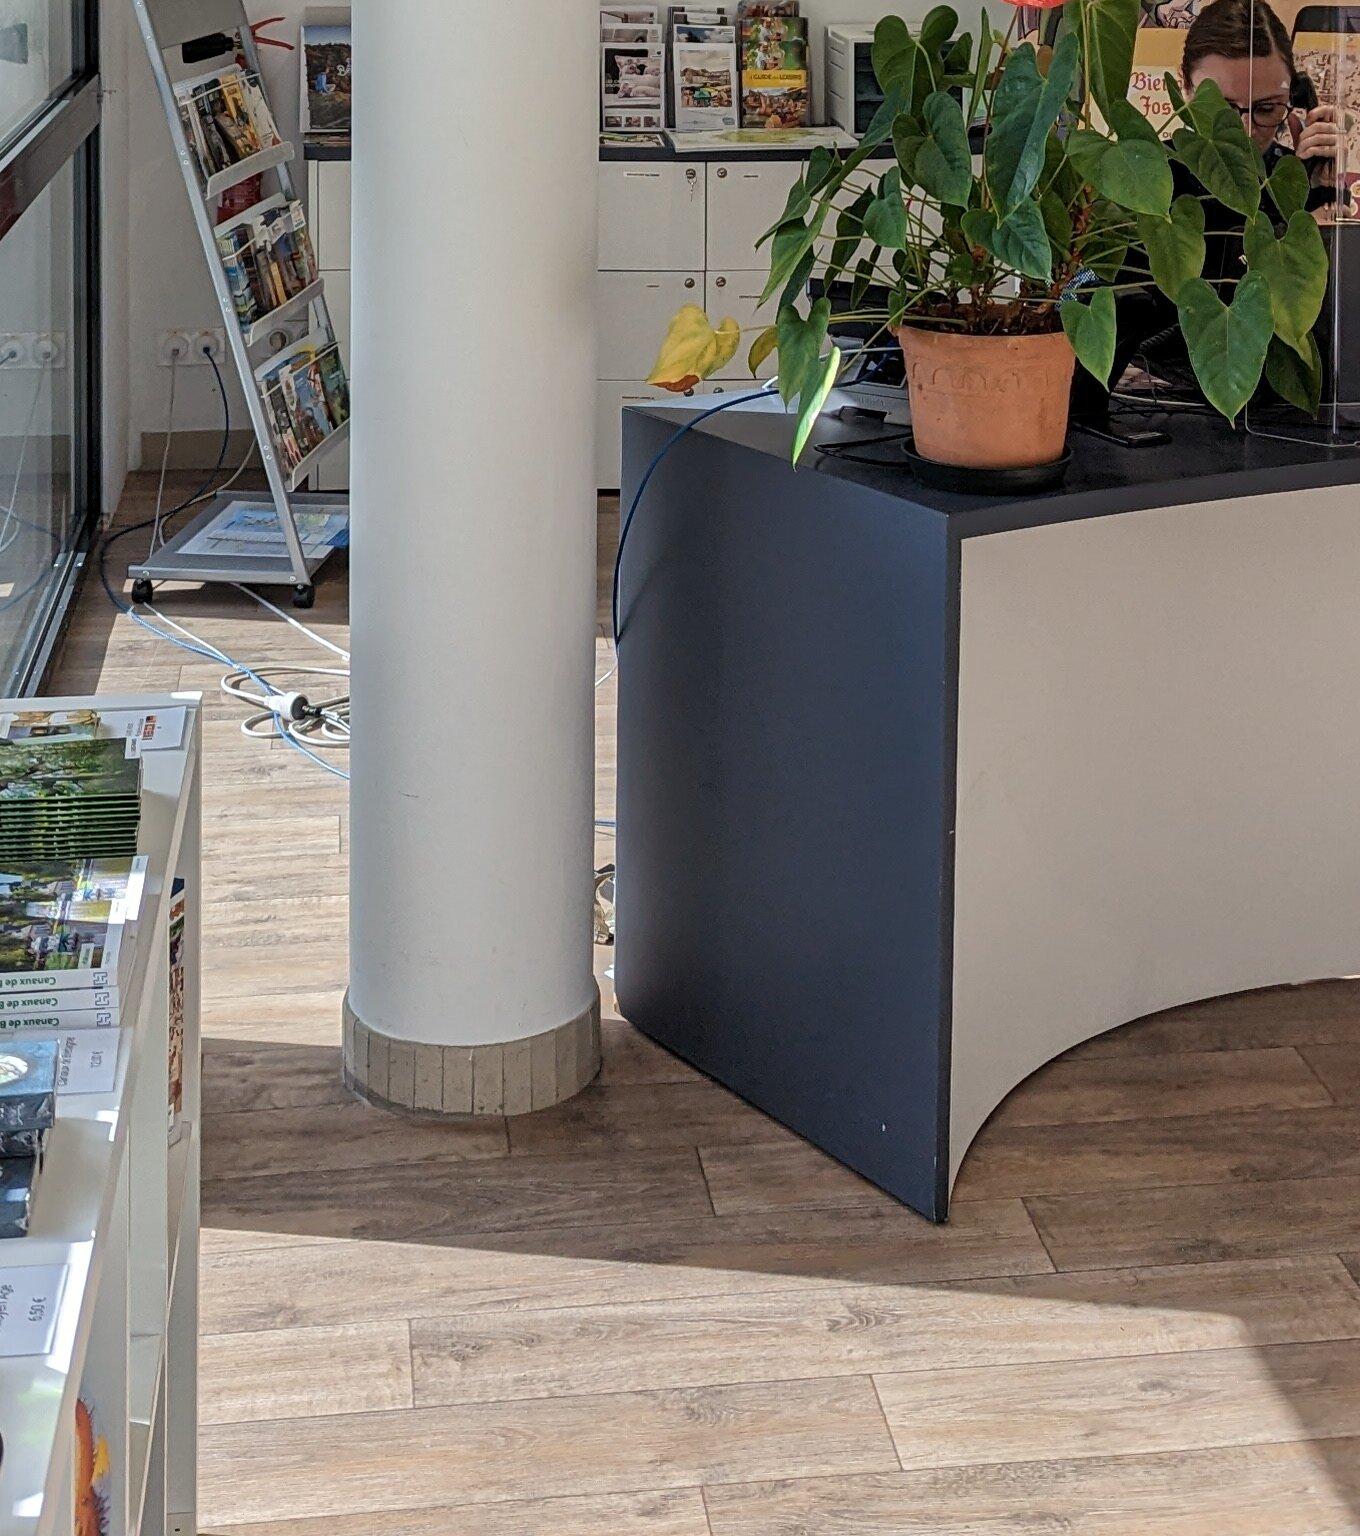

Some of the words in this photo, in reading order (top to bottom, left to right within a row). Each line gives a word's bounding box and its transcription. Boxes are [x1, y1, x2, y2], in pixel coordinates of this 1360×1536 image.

[5, 978, 17, 987] de
[19, 976, 57, 986] Canaux
[7, 999, 19, 1008] de
[21, 997, 58, 1007] Canaux
[8, 1019, 21, 1029] de
[23, 1017, 60, 1027] Canaux
